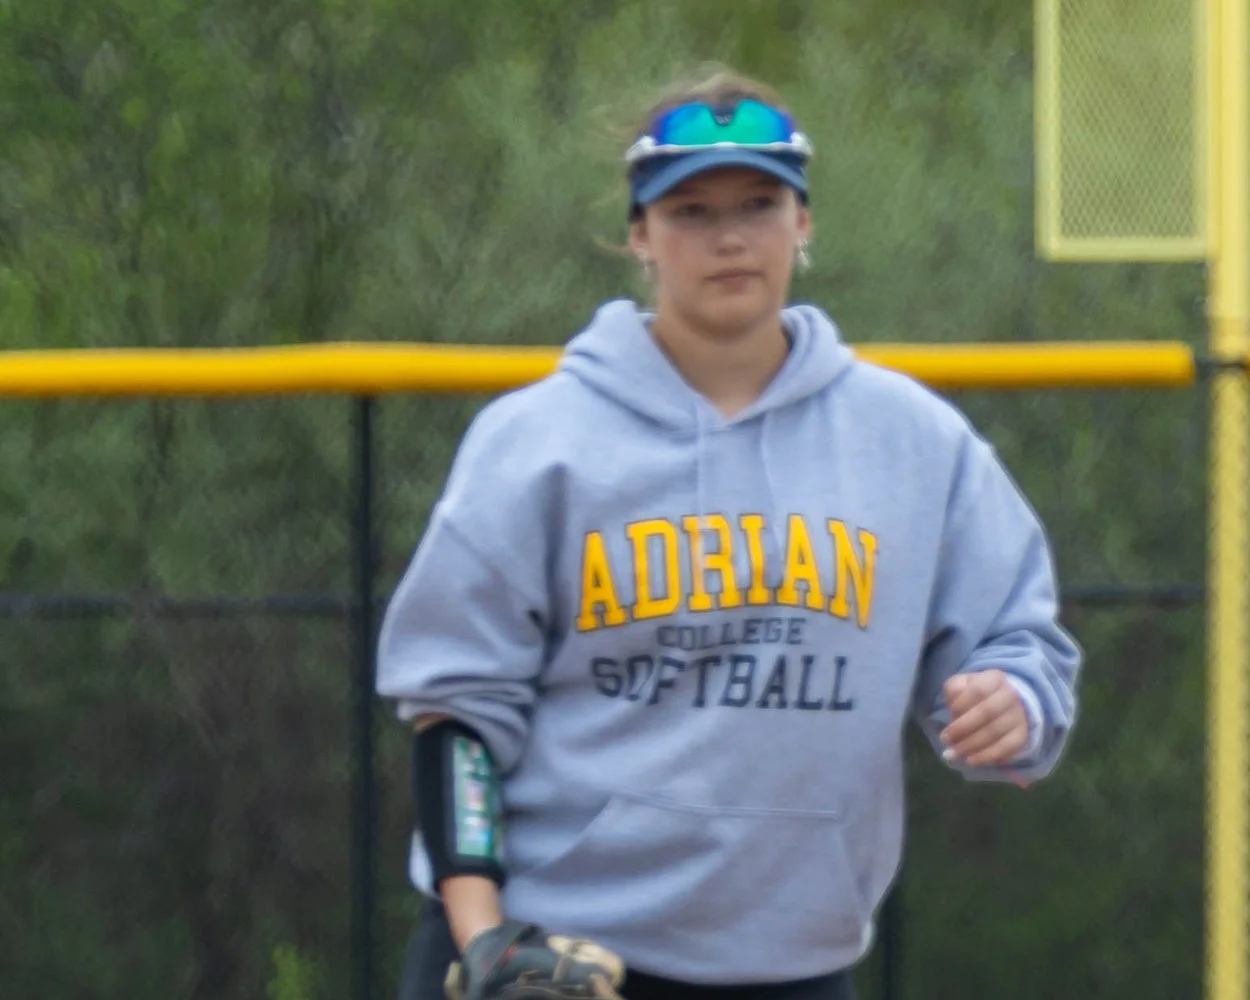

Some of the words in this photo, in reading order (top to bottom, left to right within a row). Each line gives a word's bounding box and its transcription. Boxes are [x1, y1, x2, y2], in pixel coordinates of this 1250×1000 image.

[576, 513, 878, 632] ADRIAN
[656, 617, 807, 650] COLLEGE
[591, 654, 854, 710] SOFTBALL
